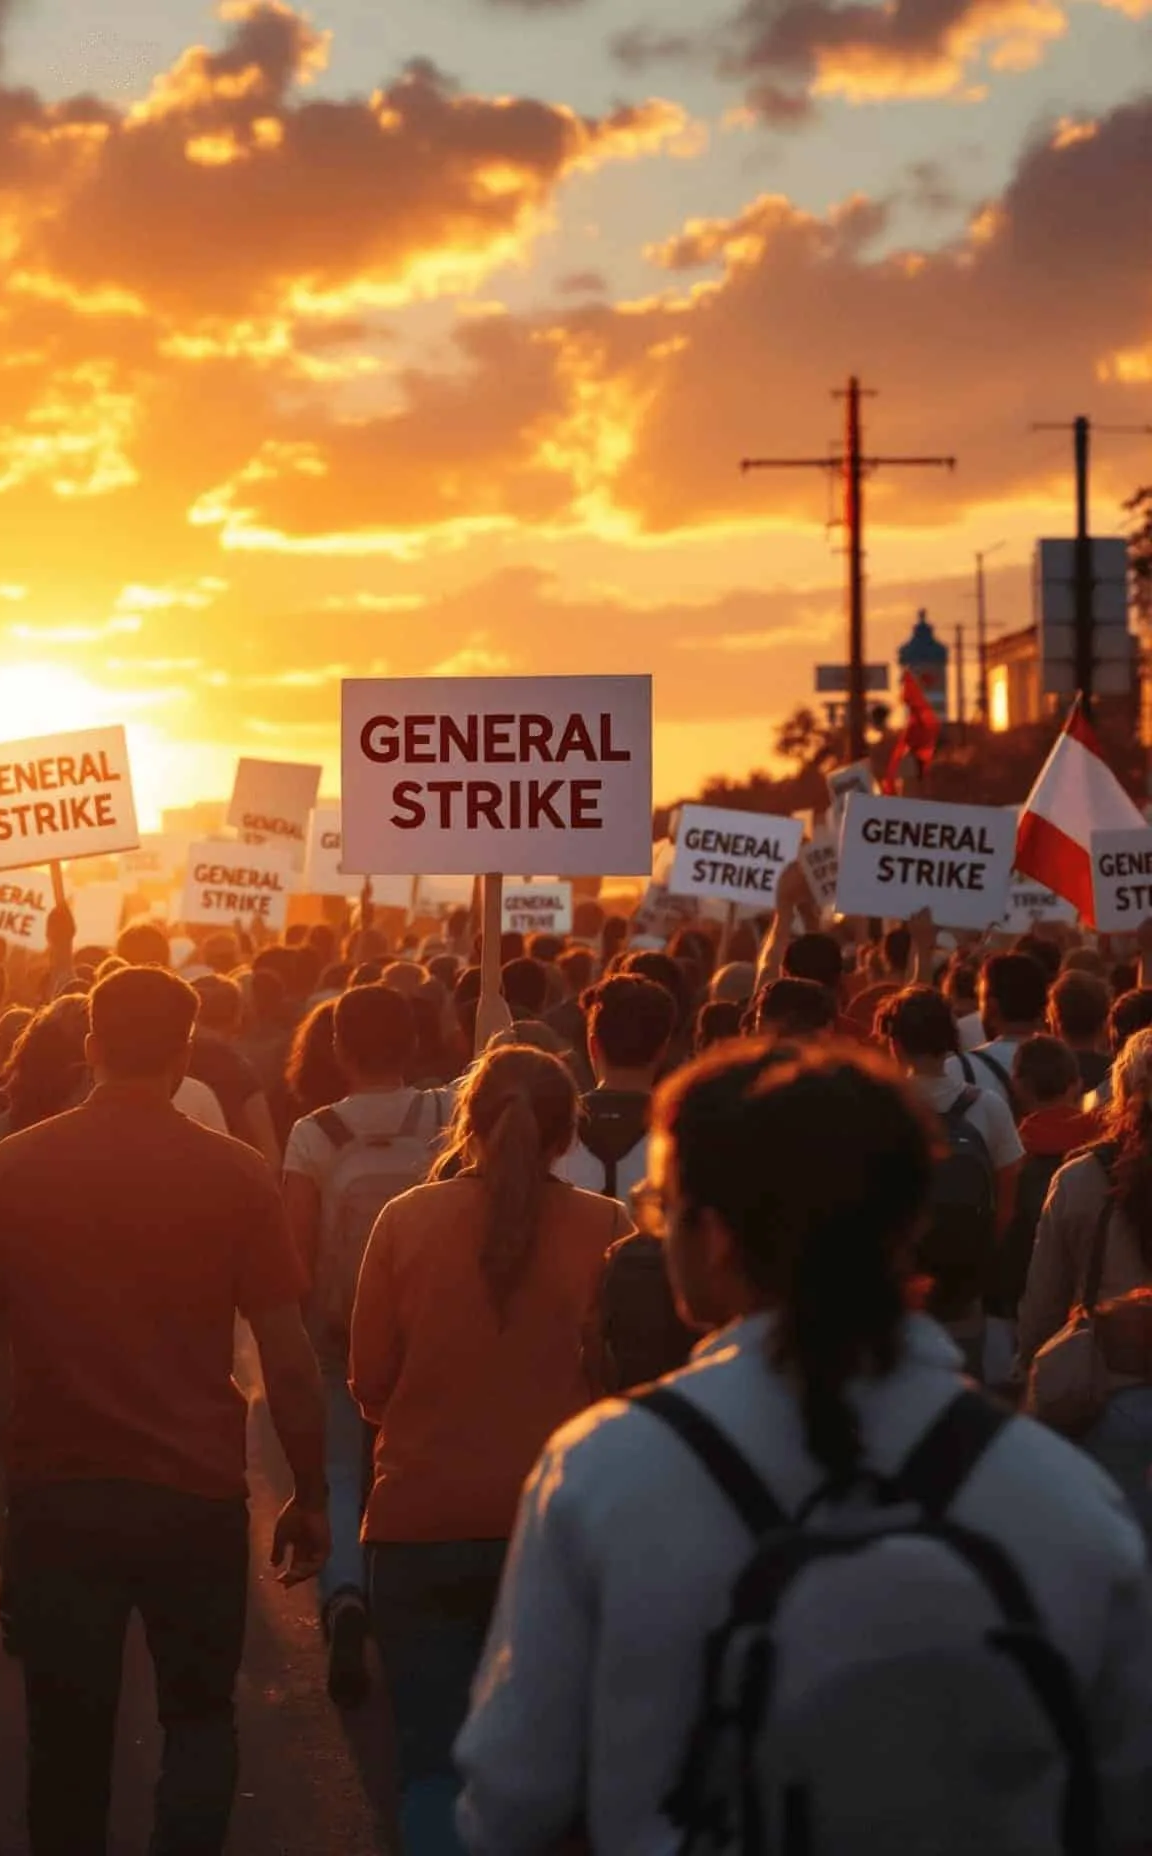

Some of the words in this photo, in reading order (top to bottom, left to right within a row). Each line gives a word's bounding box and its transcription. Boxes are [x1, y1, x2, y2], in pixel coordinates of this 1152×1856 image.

[360, 713, 631, 763] GENERAL
[390, 780, 602, 829] STRIKE
[685, 828, 784, 862] GENERAL
[862, 818, 994, 854] GENERAL
[194, 864, 283, 892] GENERAL
[692, 858, 775, 892] STRIKE
[877, 857, 986, 890] STRIKE
[202, 891, 272, 915] STRIKE
